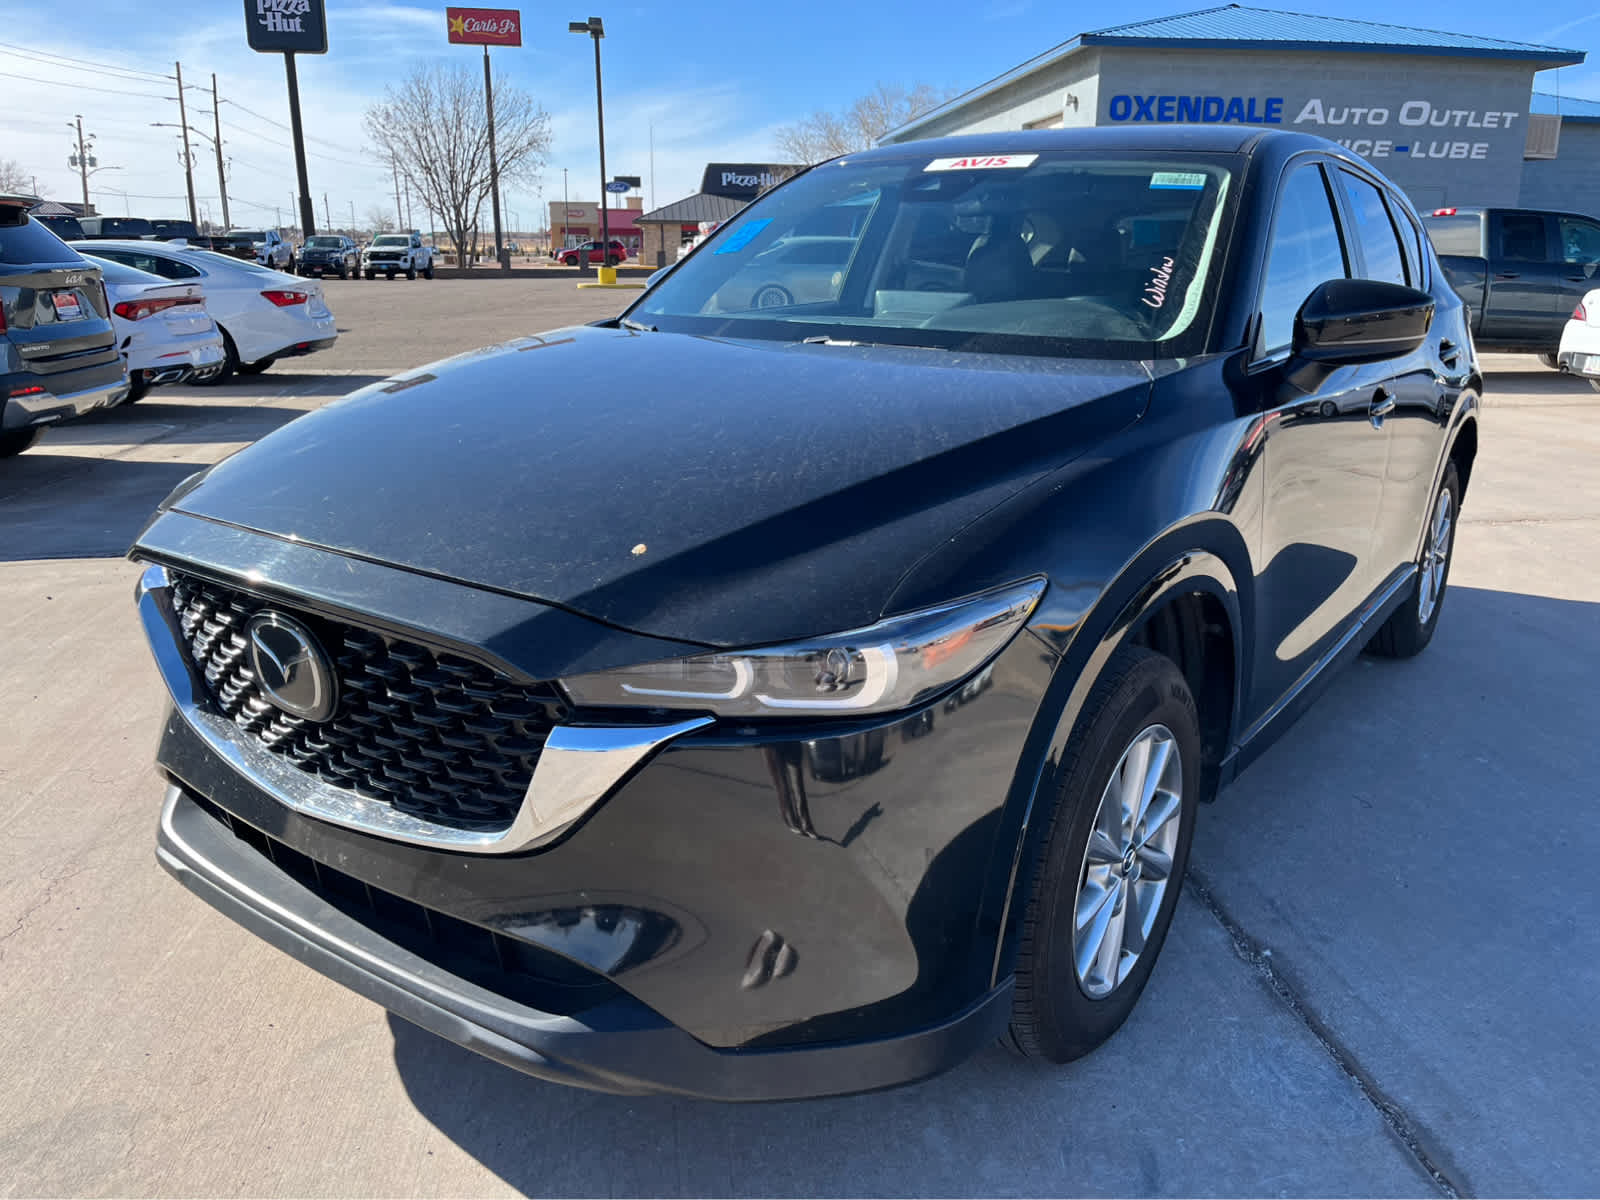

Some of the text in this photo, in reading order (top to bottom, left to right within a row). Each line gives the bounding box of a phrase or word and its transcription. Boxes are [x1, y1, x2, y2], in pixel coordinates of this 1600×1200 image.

[258, 11, 303, 32] Hut
[463, 17, 498, 33] Carl's
[1109, 95, 1284, 123] OXENDALE
[948, 156, 1012, 169] AVIS
[721, 172, 758, 186] Pizza
